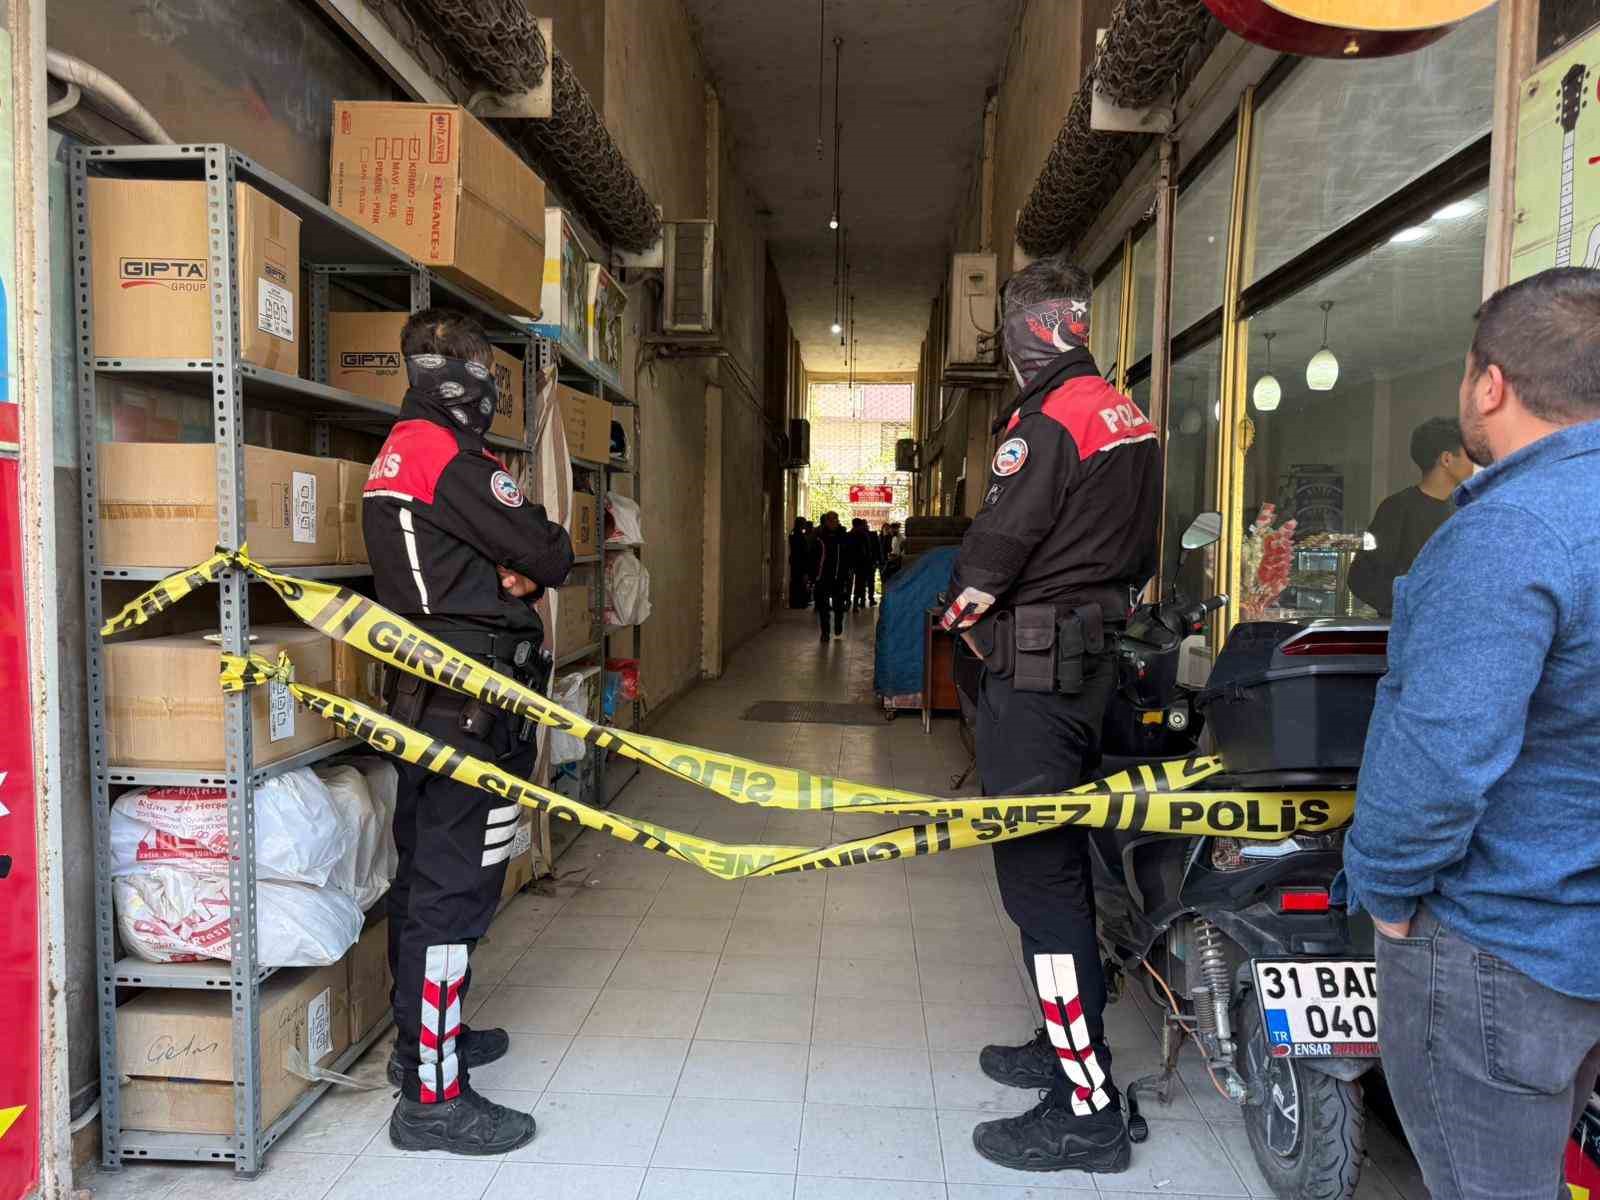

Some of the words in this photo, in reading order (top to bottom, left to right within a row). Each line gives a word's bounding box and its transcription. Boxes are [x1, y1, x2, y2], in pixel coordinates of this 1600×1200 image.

[371, 202, 382, 224] PINK
[405, 206, 415, 225] RED
[124, 262, 203, 278] GIPTA
[344, 354, 397, 366] GIPTA
[1169, 799, 1329, 833] POLİS
[1263, 967, 1302, 999] 31
[1305, 1005, 1377, 1038] 040
[1273, 1031, 1289, 1042] TR
[1294, 1043, 1332, 1055] ENSAR
